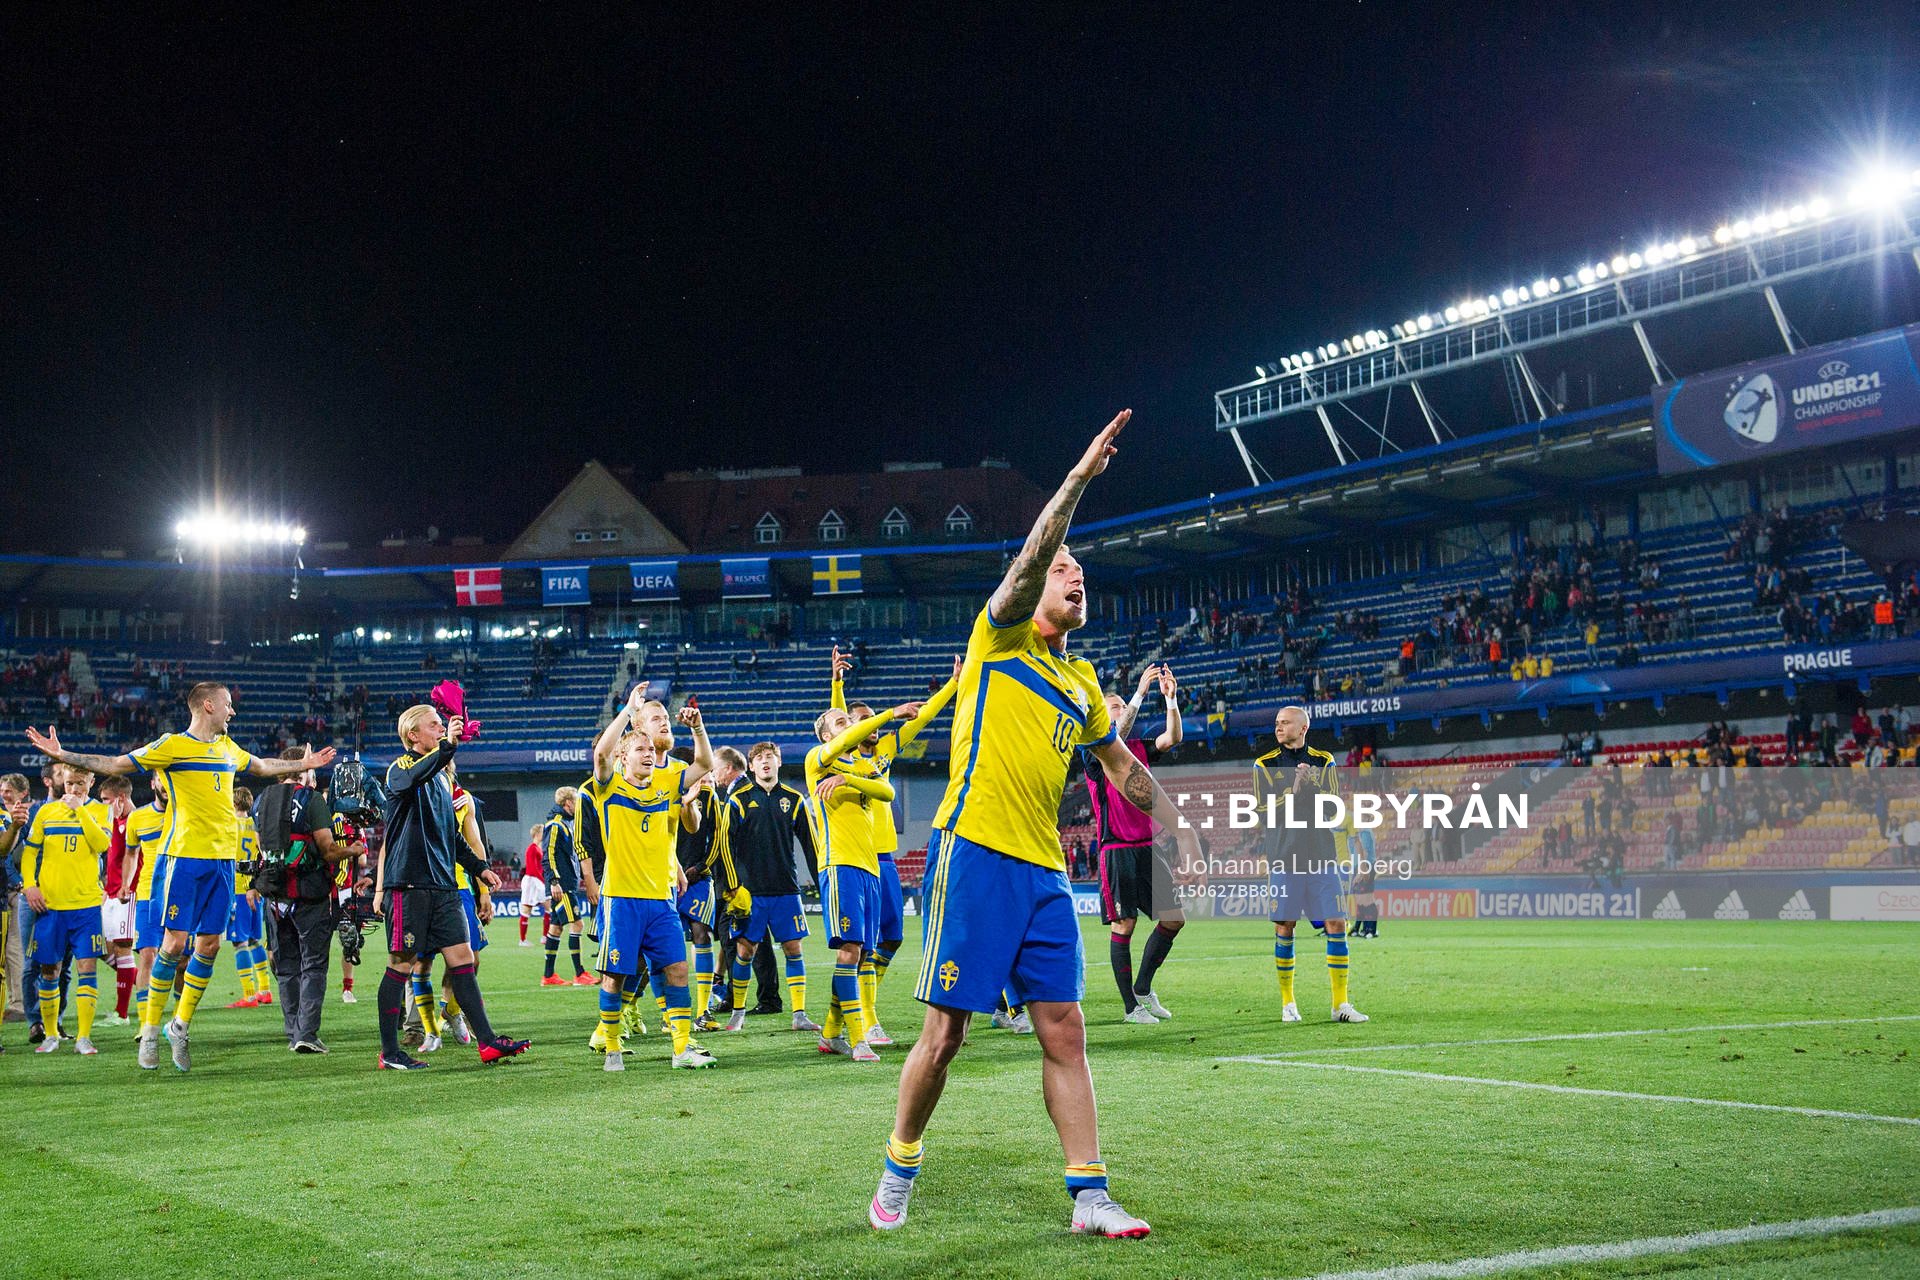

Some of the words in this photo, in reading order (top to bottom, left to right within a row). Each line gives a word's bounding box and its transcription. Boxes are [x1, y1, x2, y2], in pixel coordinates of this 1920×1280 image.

[1818, 361, 1850, 380] UEFA
[1792, 371, 1881, 404] UNDER21
[1794, 392, 1882, 420] CHAMPIONSHIP
[548, 577, 581, 590] FIFA
[633, 575, 674, 589] UEFA
[734, 574, 766, 583] RESPECT
[1783, 648, 1852, 672] PRAGUE
[1315, 700, 1368, 718] REPUBLIC
[1371, 697, 1400, 713] 2015
[1052, 712, 1075, 753] 10
[535, 751, 587, 762] PRAGUE
[213, 772, 221, 792] 3
[641, 813, 650, 833] 6
[64, 835, 77, 853] 19
[241, 837, 252, 860] 5
[688, 898, 706, 917] 21
[1388, 892, 1434, 917] lovin'
[1437, 892, 1450, 917] it
[1480, 893, 1535, 916] UEFA
[1536, 893, 1605, 916] UNDER
[1609, 892, 1635, 916] 21
[120, 920, 126, 935] 8
[793, 914, 806, 932] 13
[91, 934, 102, 952] 19
